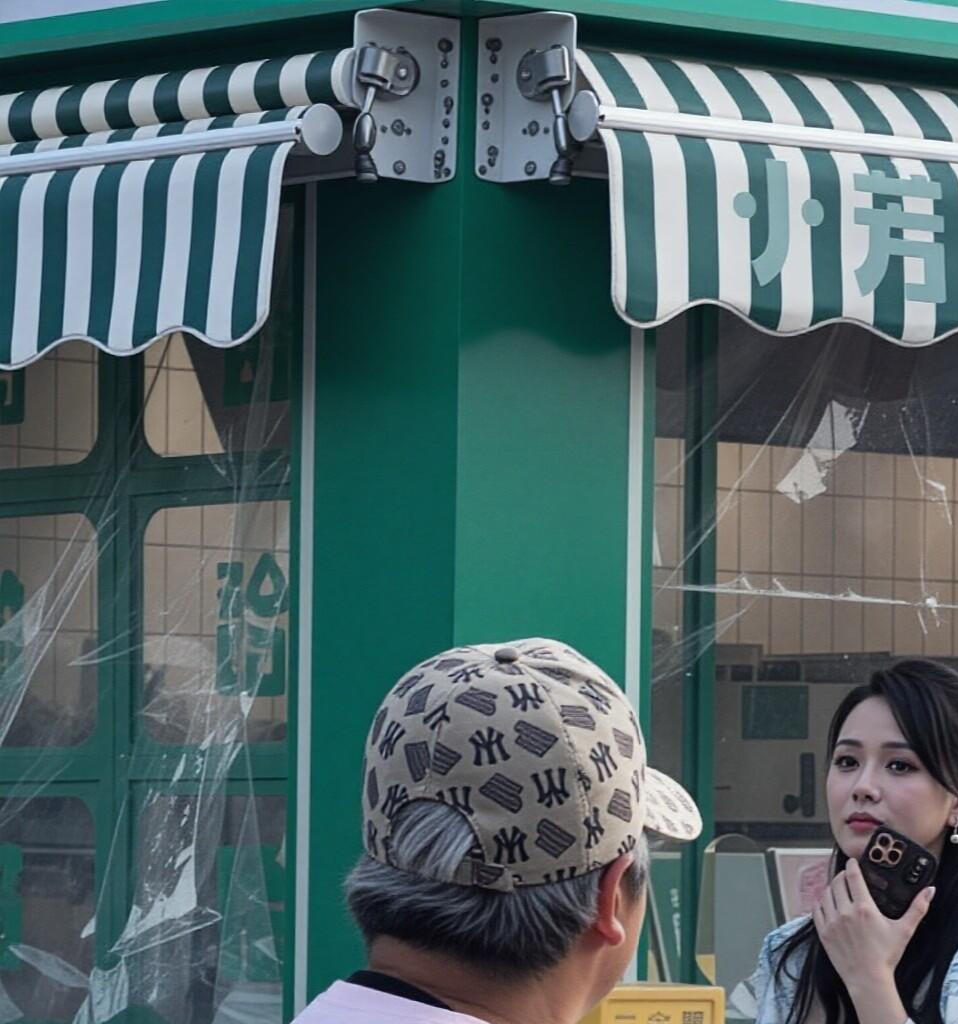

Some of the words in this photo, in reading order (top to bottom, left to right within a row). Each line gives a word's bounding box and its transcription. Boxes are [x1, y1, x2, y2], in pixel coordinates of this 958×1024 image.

[469, 726, 511, 767] NY
[589, 741, 618, 783] NY
[493, 826, 530, 864] NY
